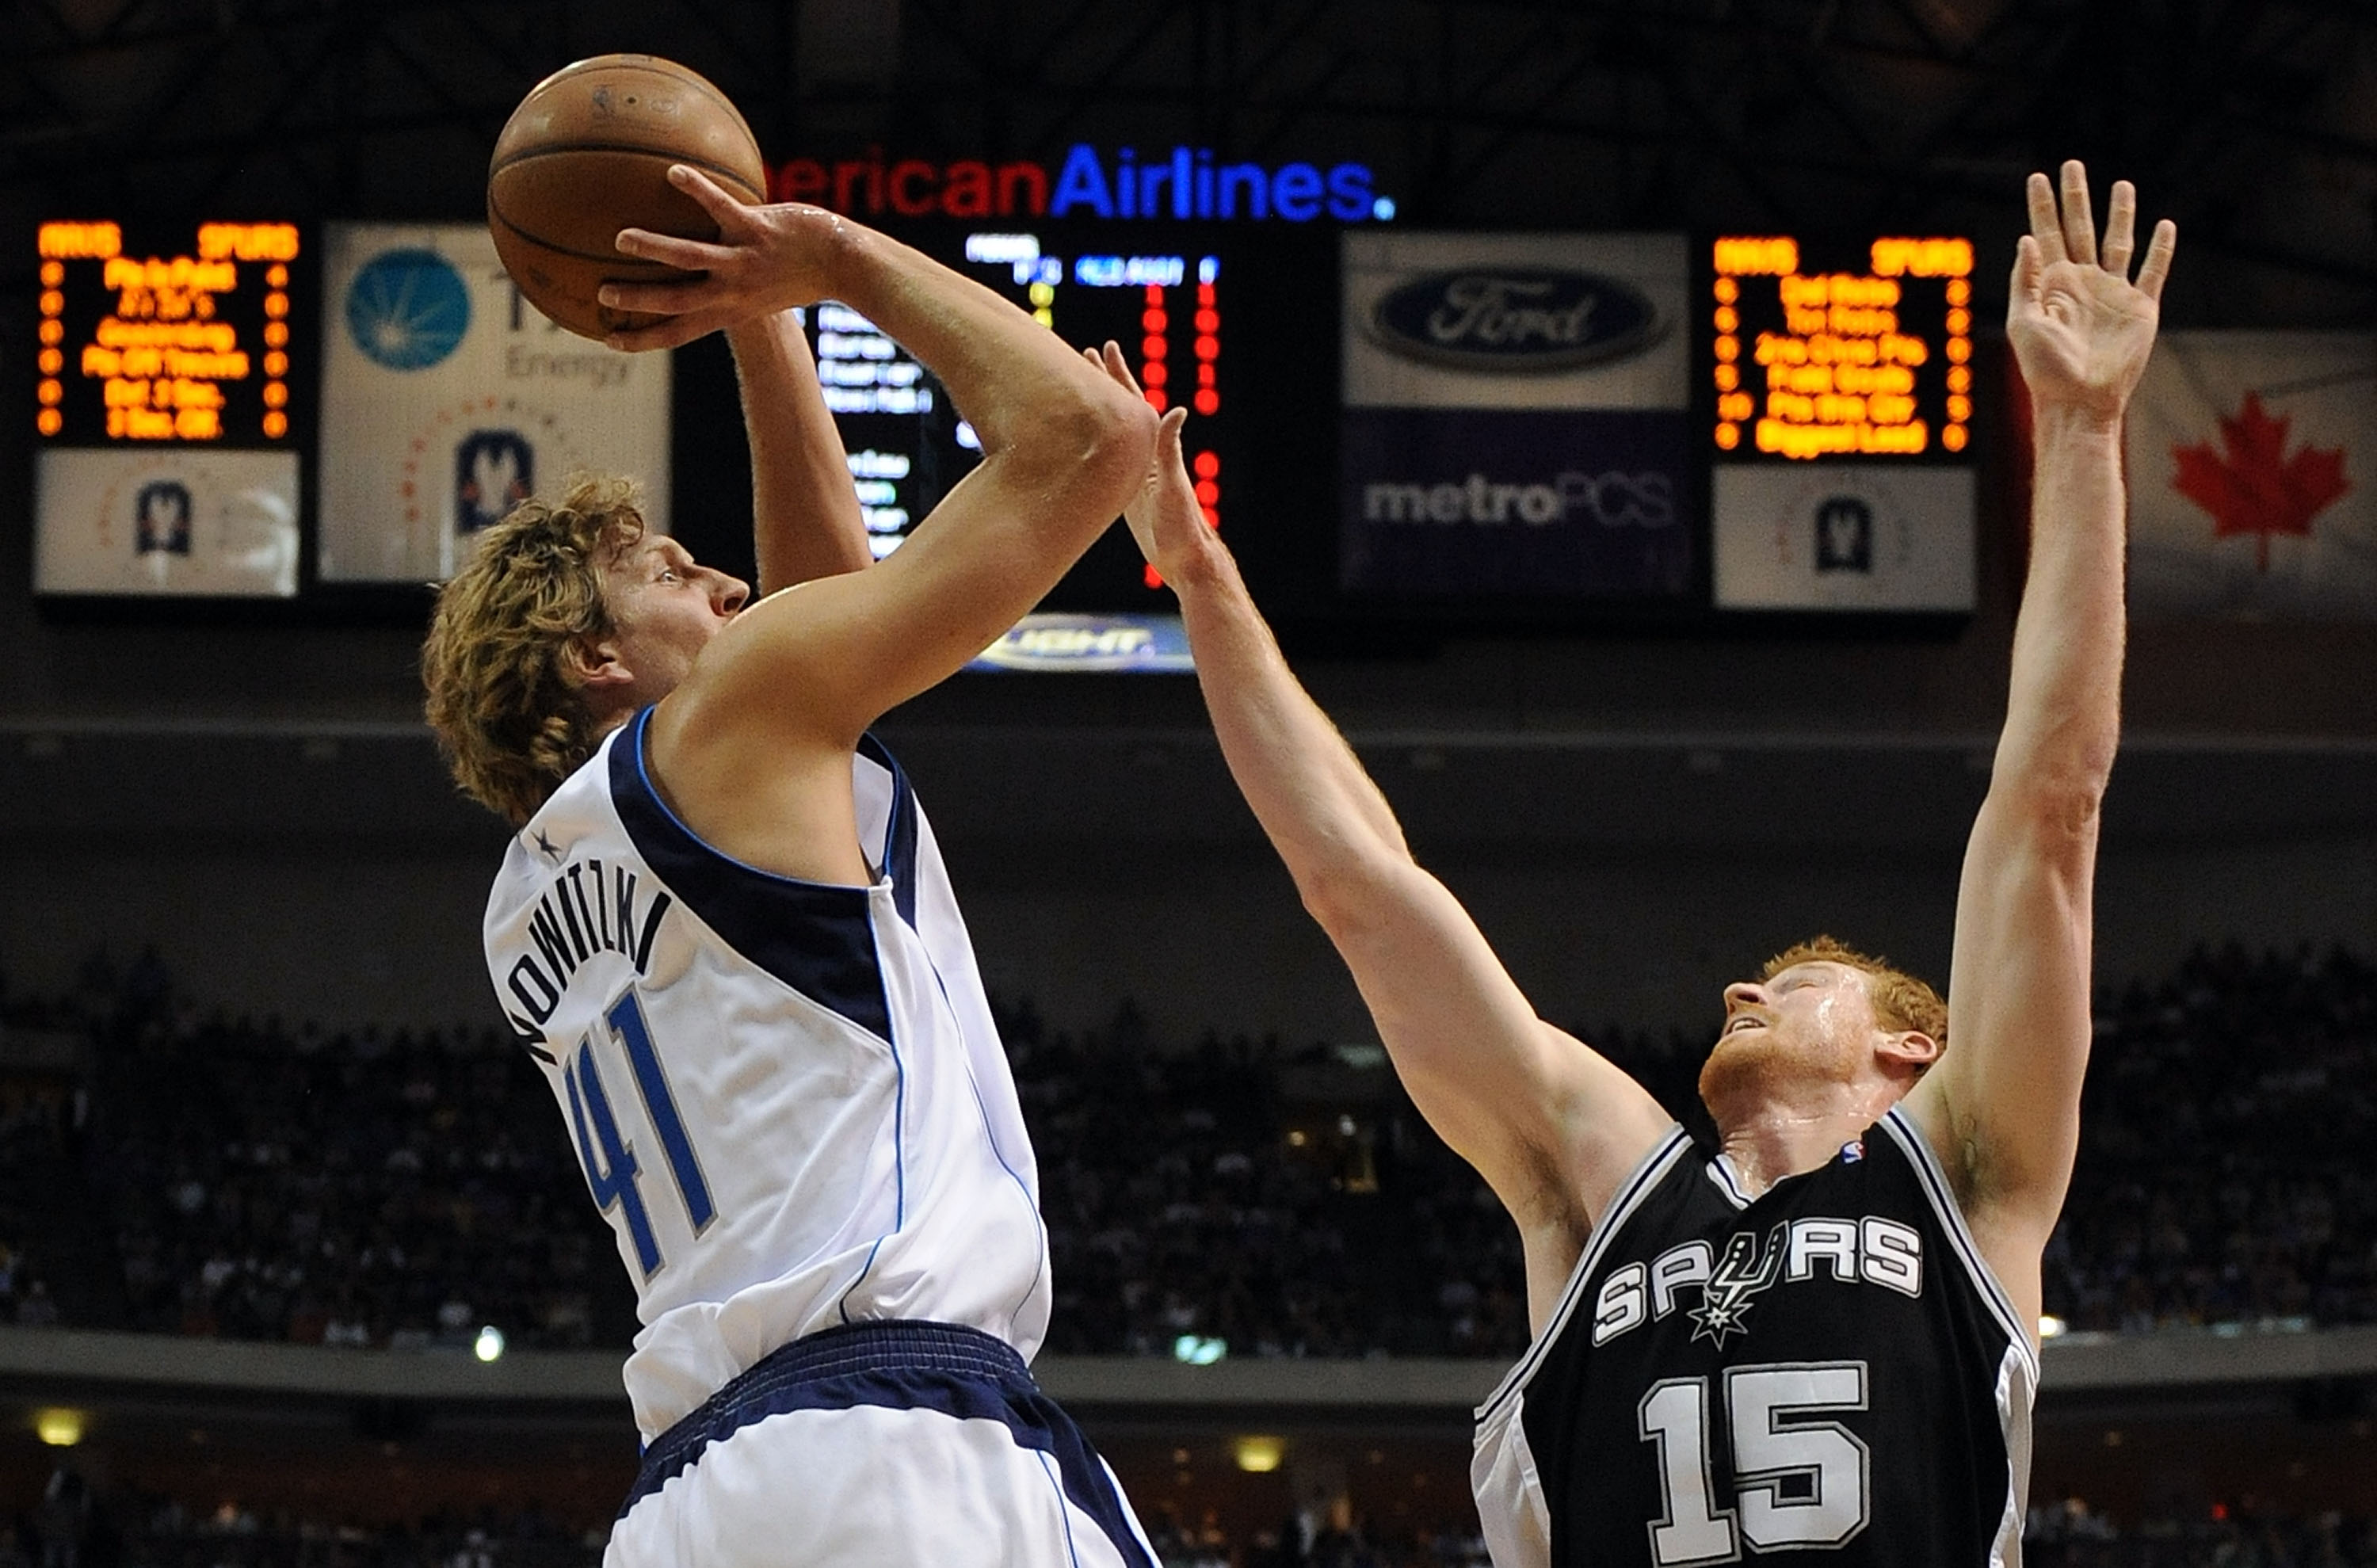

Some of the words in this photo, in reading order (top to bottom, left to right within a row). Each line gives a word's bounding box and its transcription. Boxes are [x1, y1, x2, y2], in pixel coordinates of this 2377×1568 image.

[1428, 274, 1595, 343] Ford
[505, 344, 631, 390] Energy
[1364, 471, 1674, 526] metroPCS
[564, 979, 719, 1286] 41
[1593, 1215, 1924, 1350] SPURS
[1637, 1360, 1871, 1568] 15
